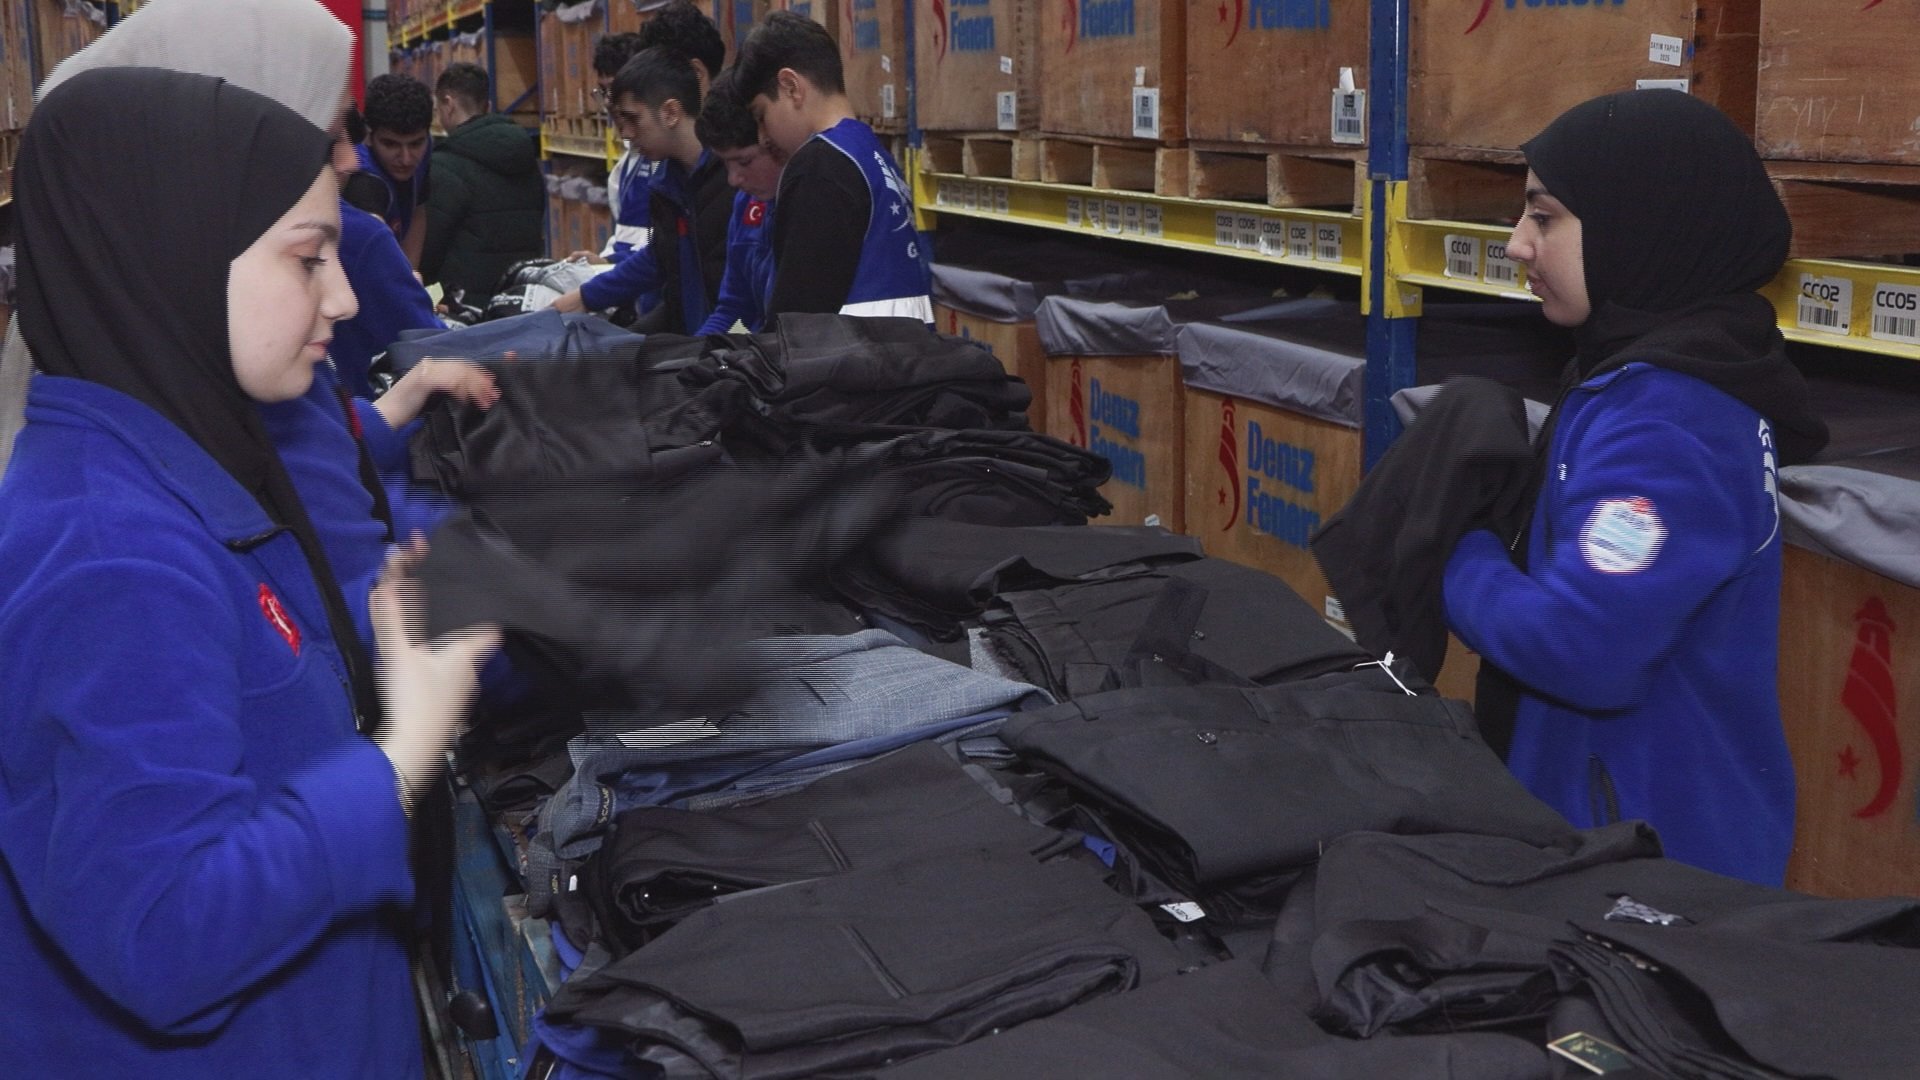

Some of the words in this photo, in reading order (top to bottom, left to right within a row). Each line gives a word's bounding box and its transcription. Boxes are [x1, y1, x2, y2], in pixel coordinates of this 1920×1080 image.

[1262, 222, 1281, 234] CD09
[1487, 245, 1506, 259] CC0
[1802, 282, 1841, 302] CC02
[1876, 291, 1918, 311] CC05
